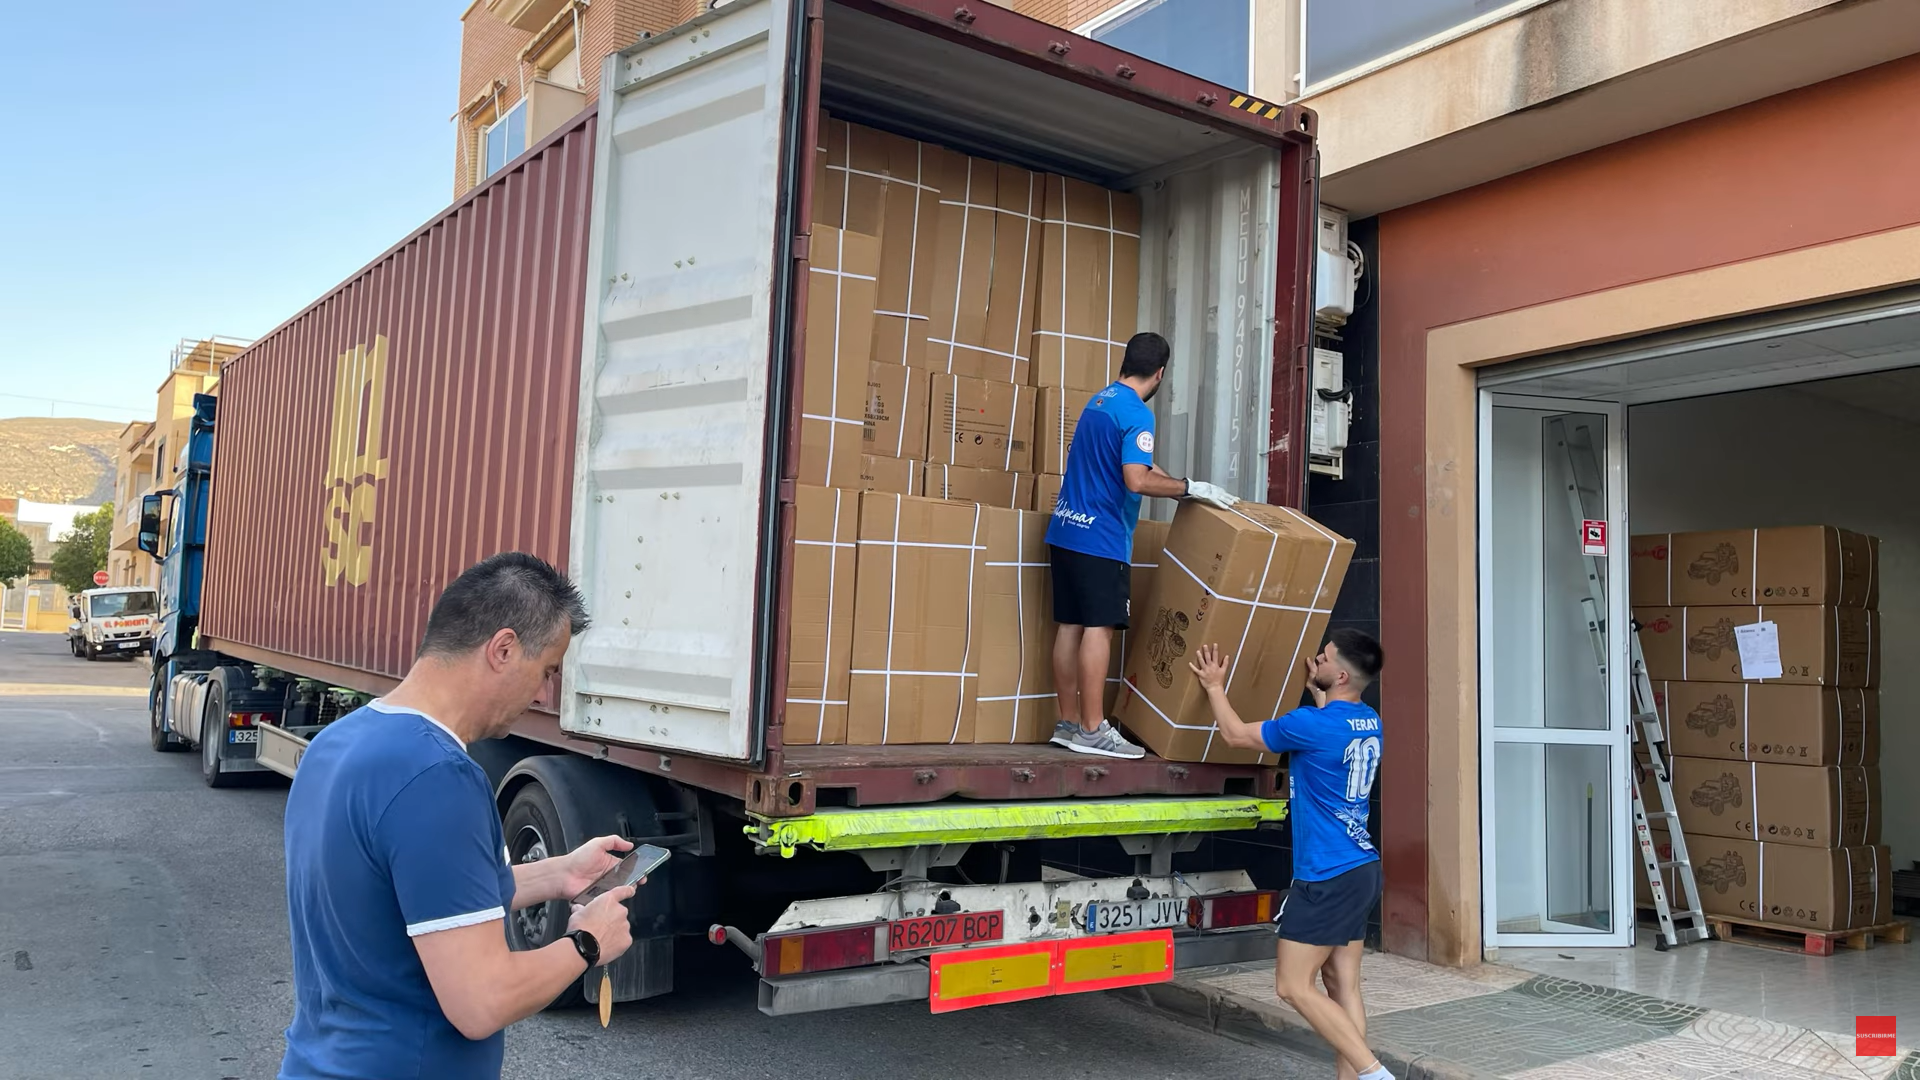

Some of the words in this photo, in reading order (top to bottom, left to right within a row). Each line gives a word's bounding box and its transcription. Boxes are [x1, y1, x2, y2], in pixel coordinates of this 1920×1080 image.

[1238, 186, 1251, 284] MEDU
[1231, 294, 1246, 442] 949015
[1229, 452, 1238, 477] 4
[237, 731, 258, 742] 325
[1346, 717, 1379, 731] YERAY
[1343, 736, 1381, 802] 10
[963, 914, 1000, 940] BCP
[1099, 904, 1143, 929] 3251
[1151, 900, 1183, 924] JVV
